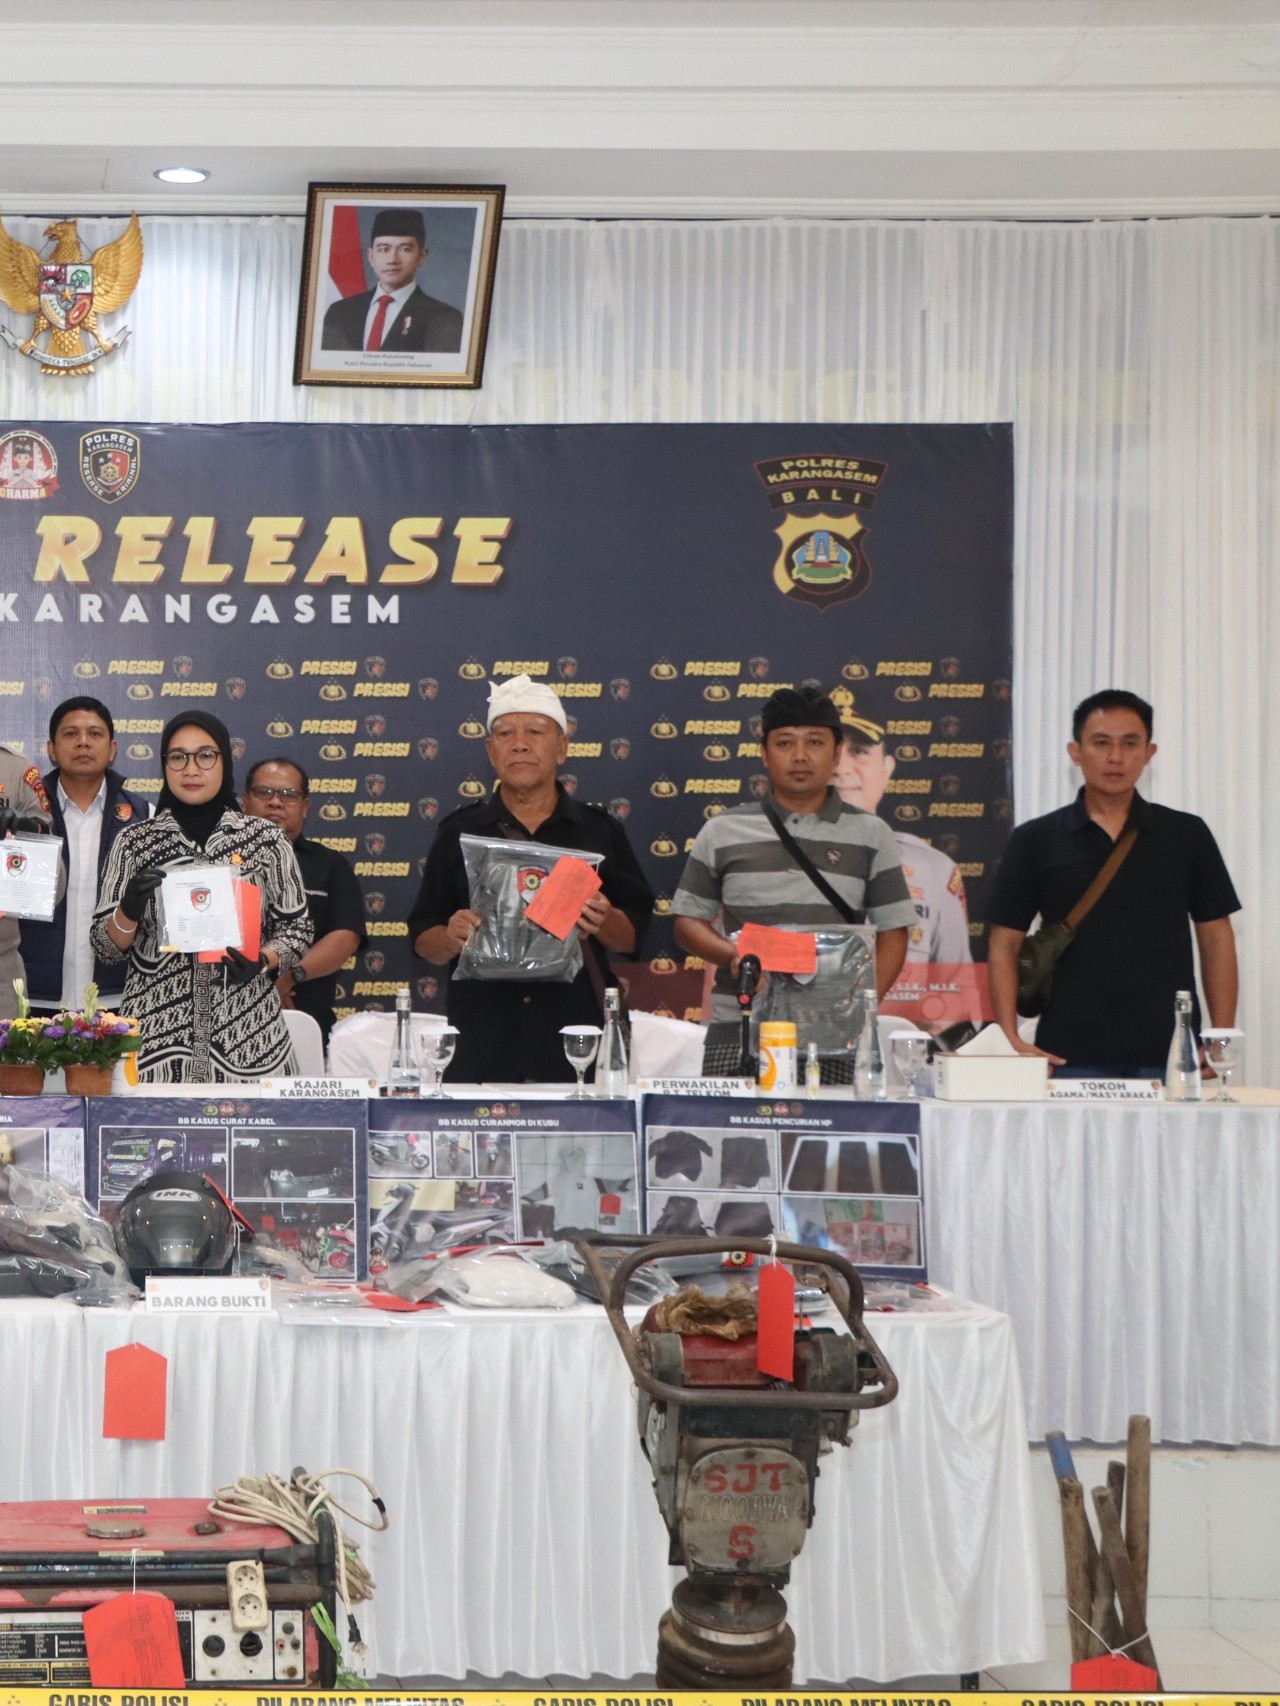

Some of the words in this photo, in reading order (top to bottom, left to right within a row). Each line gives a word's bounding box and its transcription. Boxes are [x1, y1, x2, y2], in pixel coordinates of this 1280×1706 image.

[85, 433, 135, 447] POLRES
[87, 442, 134, 453] KARANGASEM
[781, 458, 860, 471] POLRES
[82, 456, 104, 496] RESERSE
[115, 456, 137, 496] KRIMINAL
[767, 469, 878, 484] KARANGASEM
[0, 488, 46, 499] DHARMA
[781, 489, 861, 504] BALI
[32, 515, 513, 588] RELEASE
[107, 660, 164, 675] PRESISI
[300, 660, 357, 675] PRESISI
[493, 661, 549, 675] PRESISI
[684, 661, 741, 676] PRESISI
[876, 661, 932, 676] PRESISI
[161, 682, 217, 696] PRESISI
[353, 682, 410, 697] PRESISI
[928, 683, 984, 698] PRESISI
[300, 720, 357, 735] PRESISI
[684, 720, 741, 735] PRESISI
[353, 742, 410, 757] PRESISI
[567, 743, 603, 757] ESISI
[928, 742, 984, 758] PRESISI
[684, 779, 741, 794] PRESISI
[353, 802, 410, 817] PRESISI
[928, 803, 984, 817] PRESISI
[354, 862, 410, 876] PRESISI
[294, 1080, 342, 1089] KAJARI
[653, 1080, 739, 1089] PERWAKILAN
[1080, 1082, 1126, 1090] TOKOH
[279, 1089, 360, 1098] KARANGASEM
[178, 1117, 190, 1125] BB
[191, 1117, 219, 1125] KASUS
[220, 1117, 247, 1125] CURAT
[248, 1117, 276, 1125] KABEL
[438, 1118, 450, 1127] BB
[451, 1118, 479, 1127] KASUS
[480, 1118, 527, 1127] CURANMOR
[527, 1118, 536, 1127] DI
[537, 1118, 559, 1127] KUBU
[745, 1116, 771, 1125] KASUS
[772, 1118, 820, 1126] PENCURIAN
[151, 1295, 218, 1308] BARANG
[222, 1295, 266, 1308] BUKTI
[704, 1462, 791, 1493] SJT
